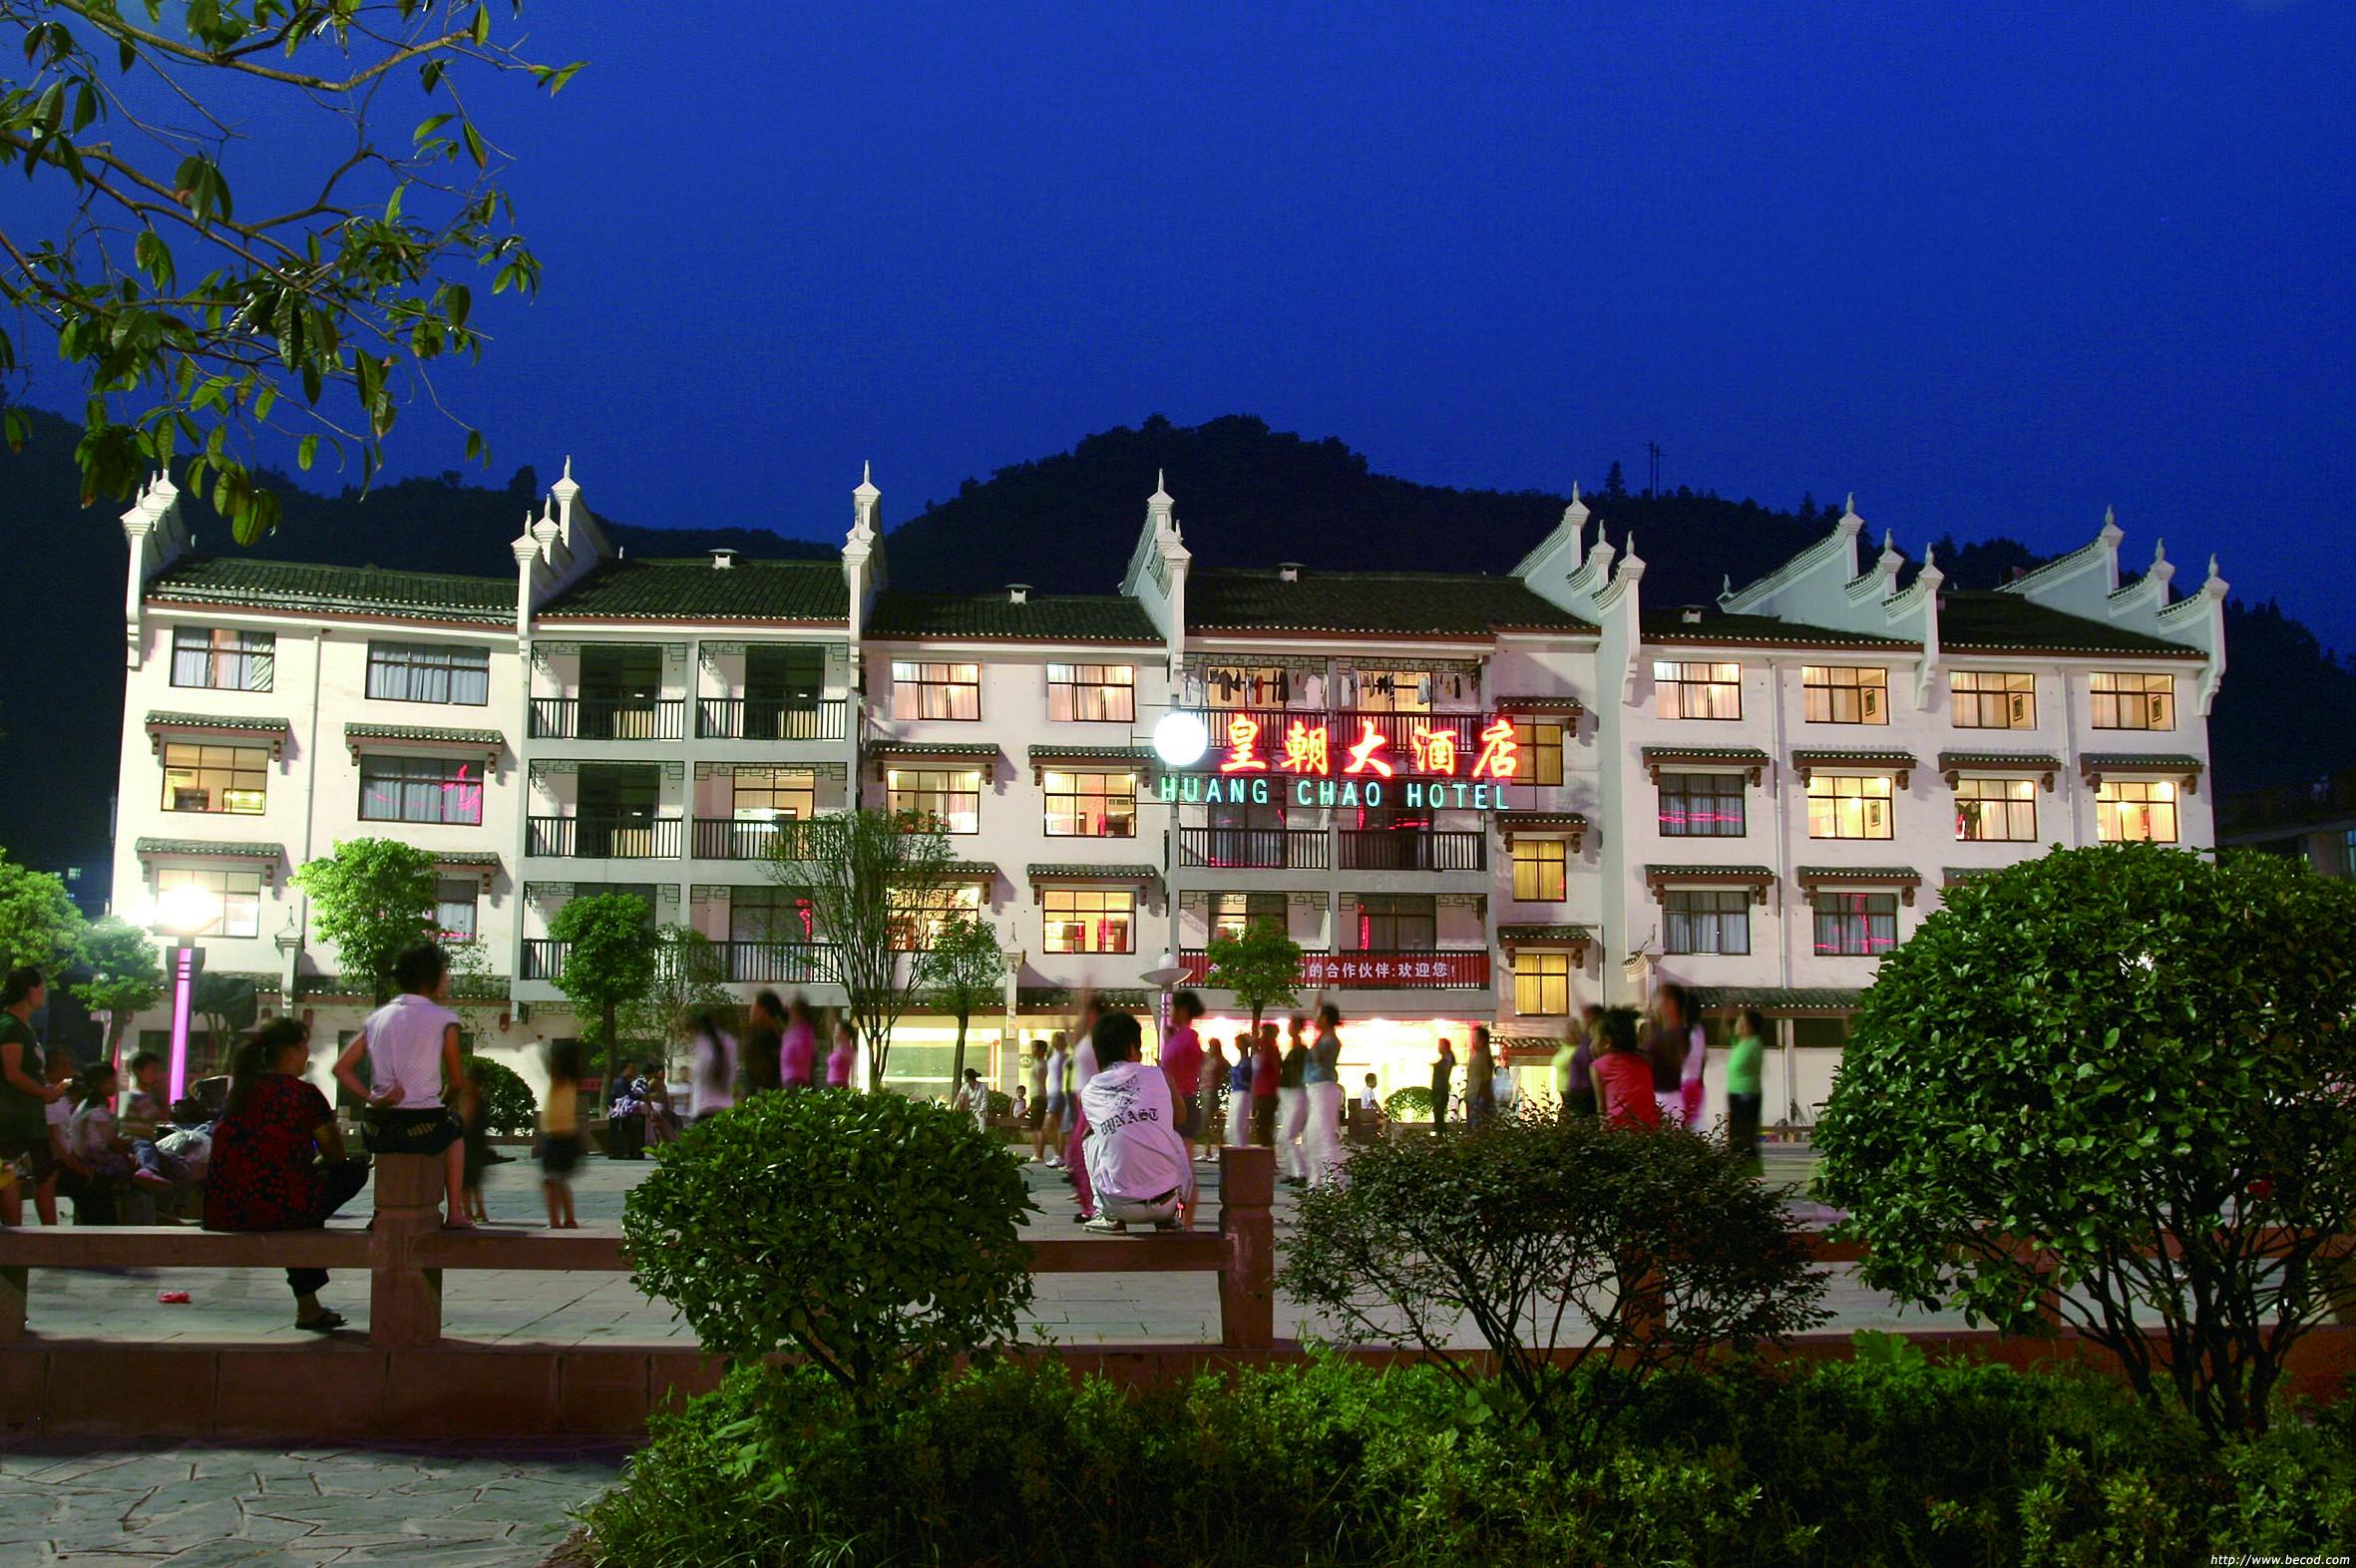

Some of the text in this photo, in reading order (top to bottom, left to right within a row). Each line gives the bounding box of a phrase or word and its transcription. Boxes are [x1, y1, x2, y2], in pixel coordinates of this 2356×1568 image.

[1220, 714, 1518, 778] 皇朝大酒店
[1160, 777, 1510, 810] HUANG CHAO HOTEL
